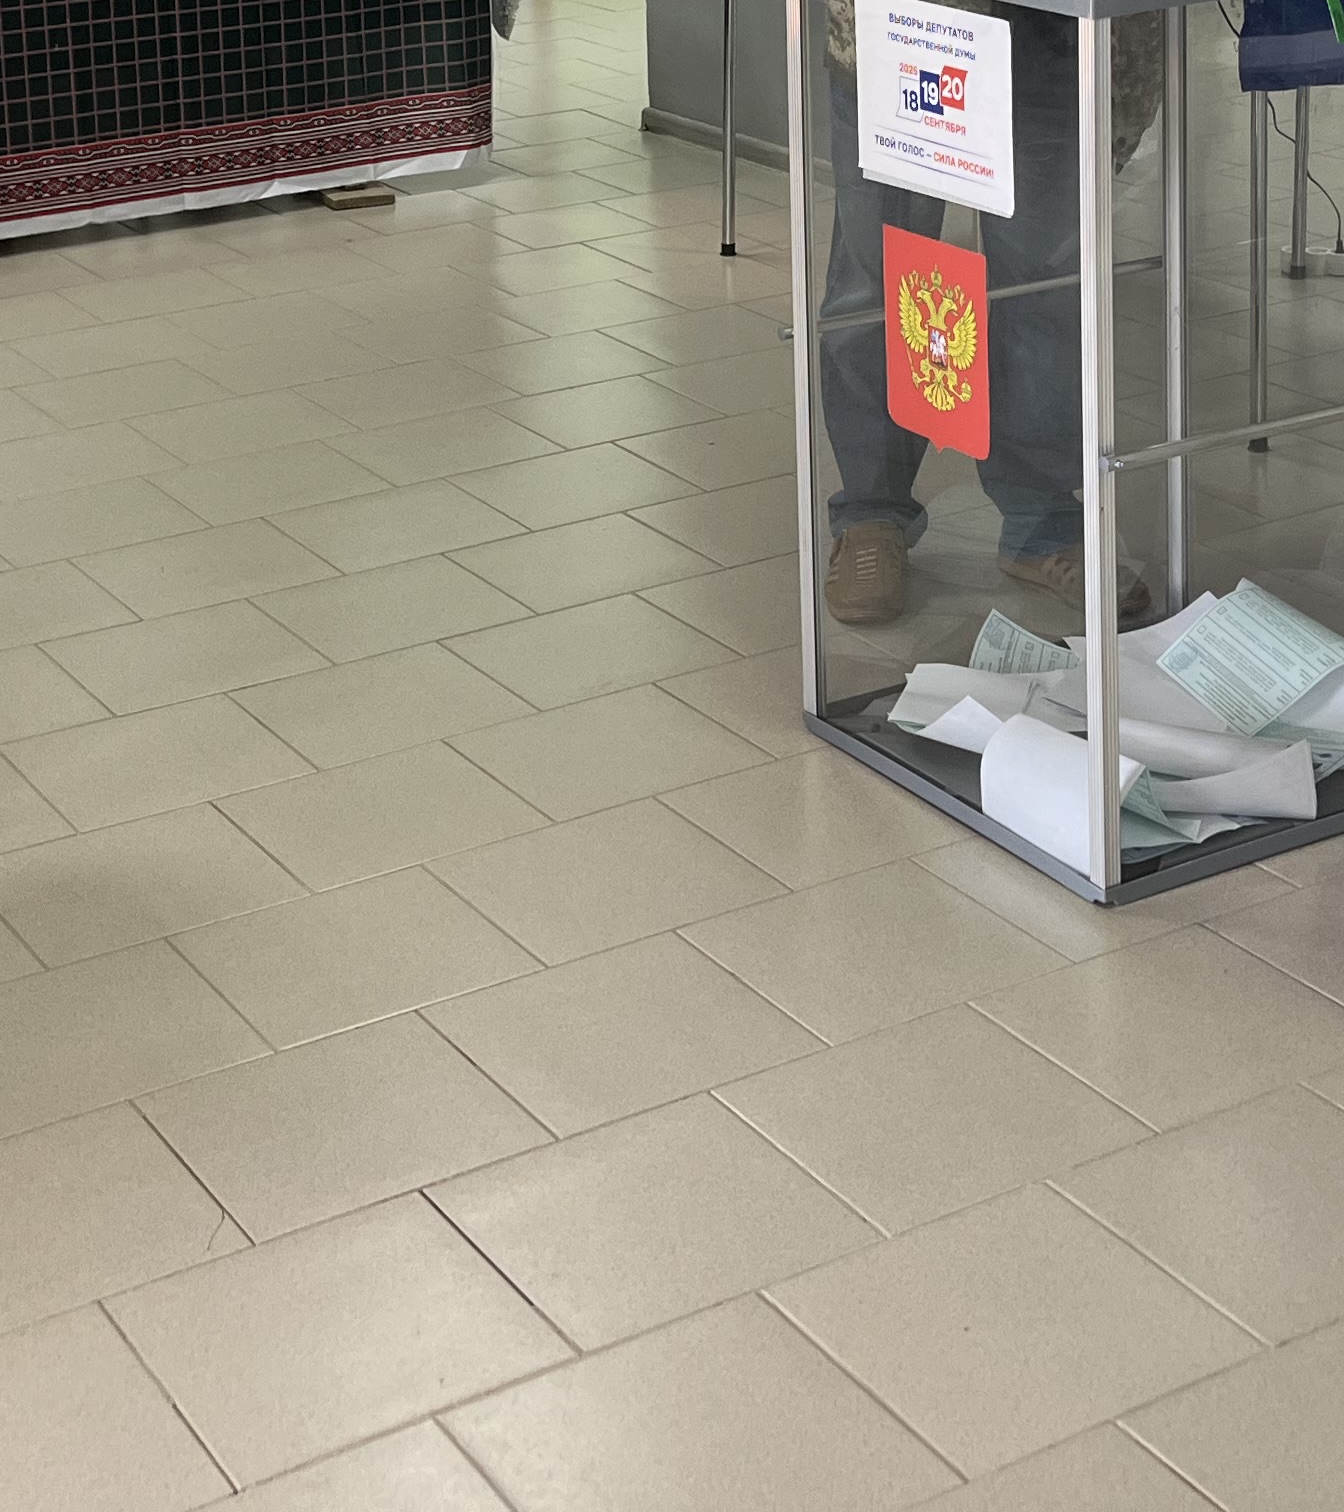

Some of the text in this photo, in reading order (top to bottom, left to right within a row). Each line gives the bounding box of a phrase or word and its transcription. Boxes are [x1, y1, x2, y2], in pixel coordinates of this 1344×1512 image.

[888, 12, 974, 42] ВЫБОРЫ ДЕПУТАТОВ
[887, 31, 976, 61] ГОСУДАРСТВЕННОЙ ДУМЫ
[902, 74, 964, 112] 18 19 20
[923, 115, 967, 137] СЕНТЯБРЯ
[874, 134, 897, 150] ТВОЙ
[897, 141, 925, 158] ГОЛОС
[933, 150, 956, 168] СИЛА
[957, 157, 995, 179] РОССИИ!
